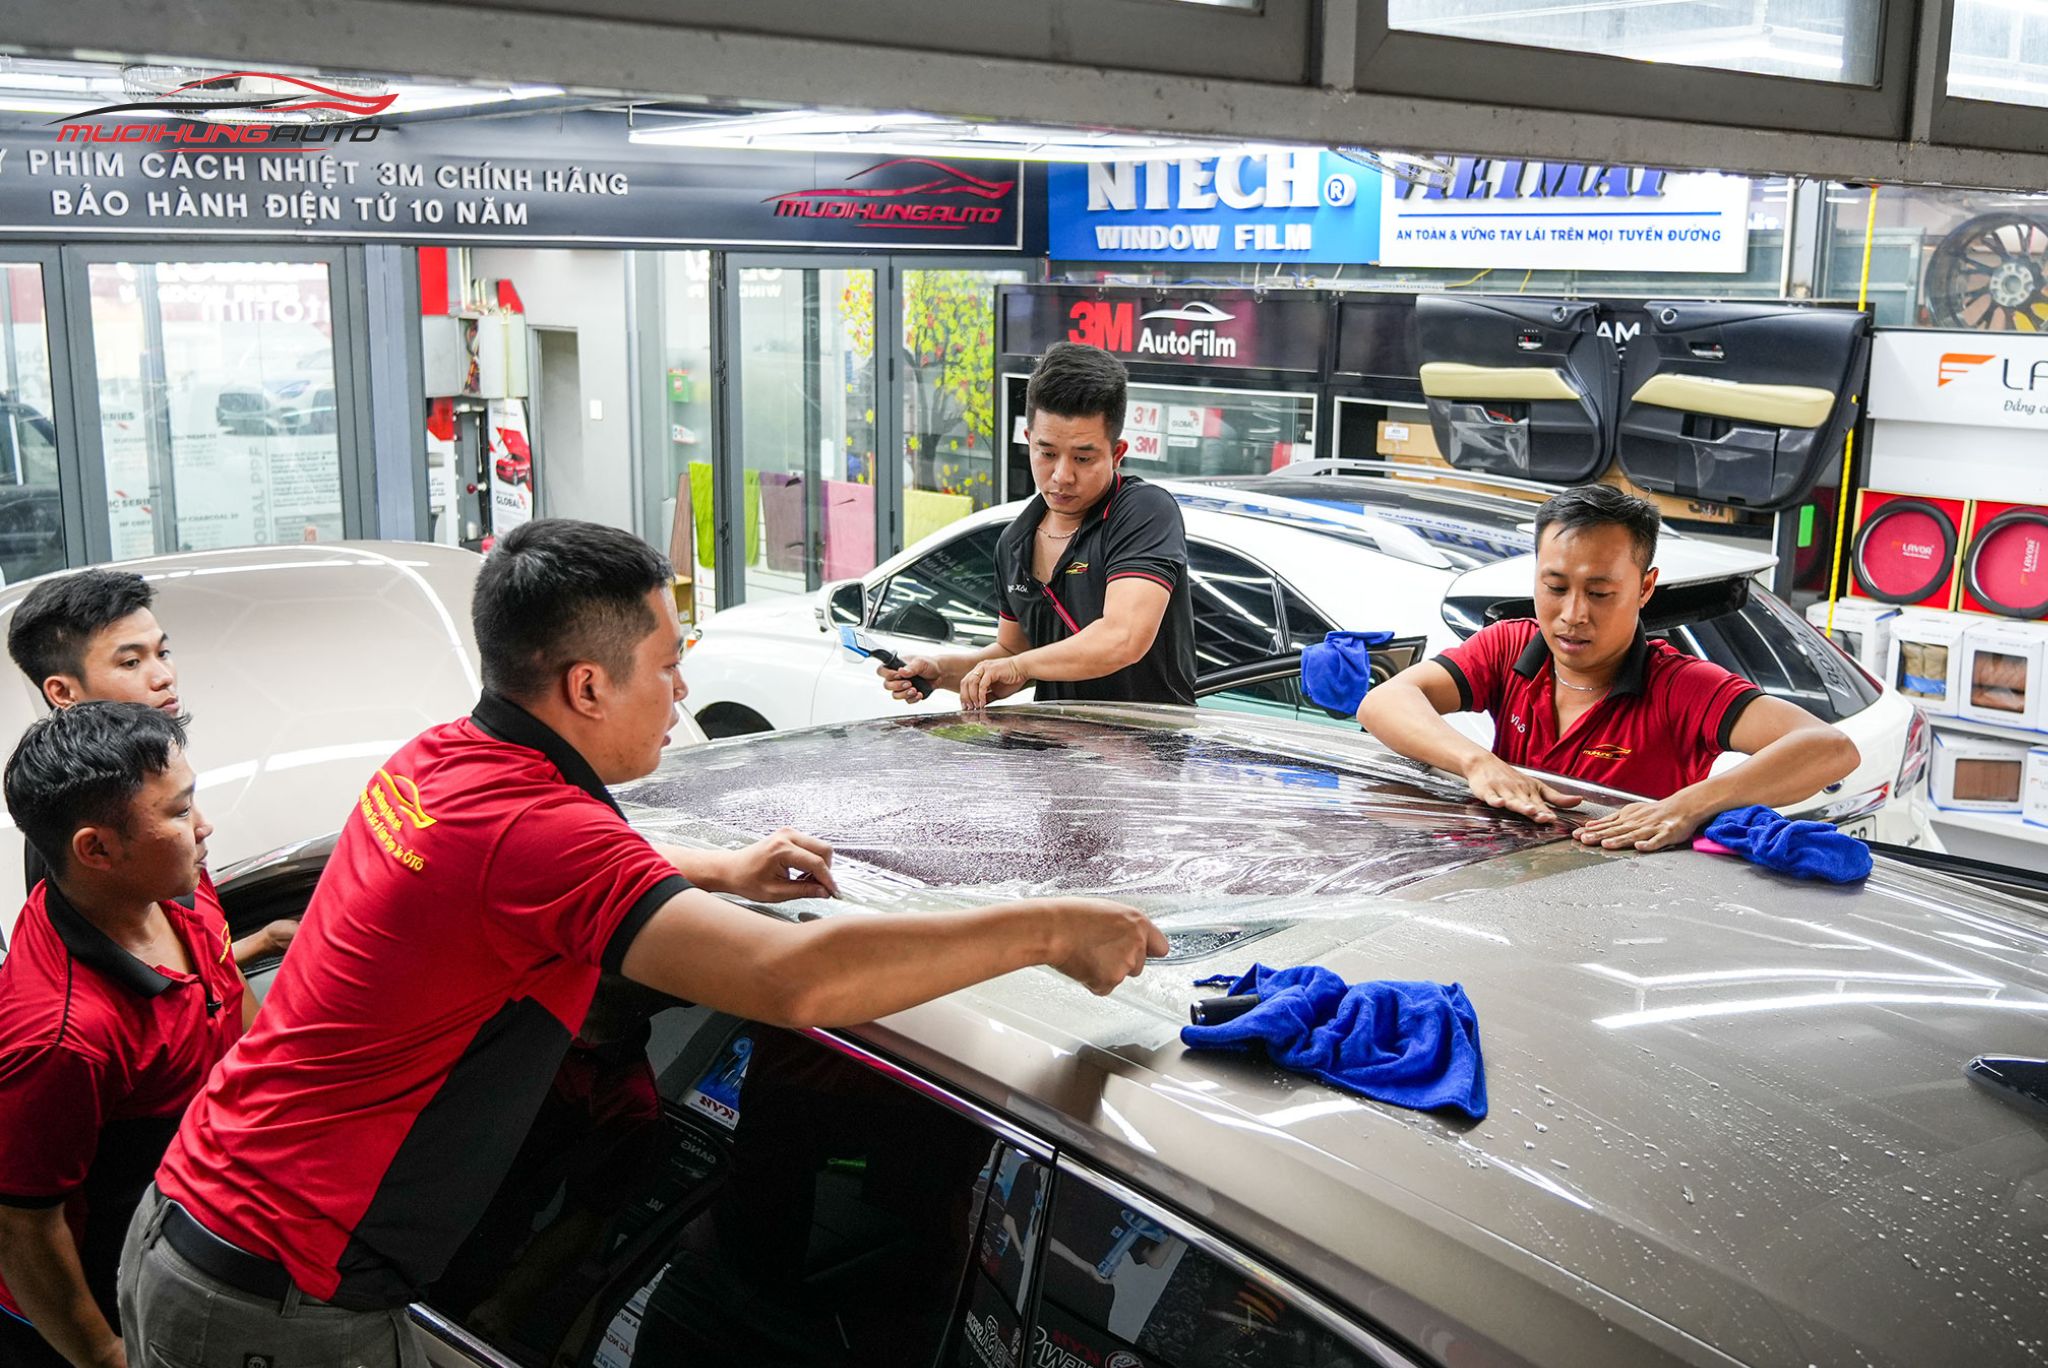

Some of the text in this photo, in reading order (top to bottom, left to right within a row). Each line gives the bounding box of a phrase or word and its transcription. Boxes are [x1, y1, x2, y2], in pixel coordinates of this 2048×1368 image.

[28, 149, 125, 177] PHIM
[260, 156, 360, 190] NHIỆT
[378, 162, 424, 188] 3M
[437, 161, 533, 192] CHÍNH
[544, 166, 629, 196] HÃNG
[51, 183, 528, 226] BẢO HÀNH ĐIỆN TỬ 10 NĂM
[1094, 224, 1312, 251] WINDOW FILM
[1396, 229, 1412, 241] AN
[1415, 226, 1447, 241] TOÀN
[1449, 229, 1457, 241] &
[1461, 226, 1496, 241] VỮNG
[1500, 229, 1523, 241] TAY
[1526, 226, 1546, 241] LÁI
[1550, 226, 1584, 241] TRÊN
[1588, 229, 1614, 244] MỌI
[1667, 224, 1722, 242] ĐƯỜNG
[1067, 301, 1237, 358] 3M AutoFilm
[1596, 321, 1641, 344] AM
[2002, 358, 2048, 391] LA
[1134, 436, 1159, 455] 3M
[253, 487, 267, 545] OBAL
